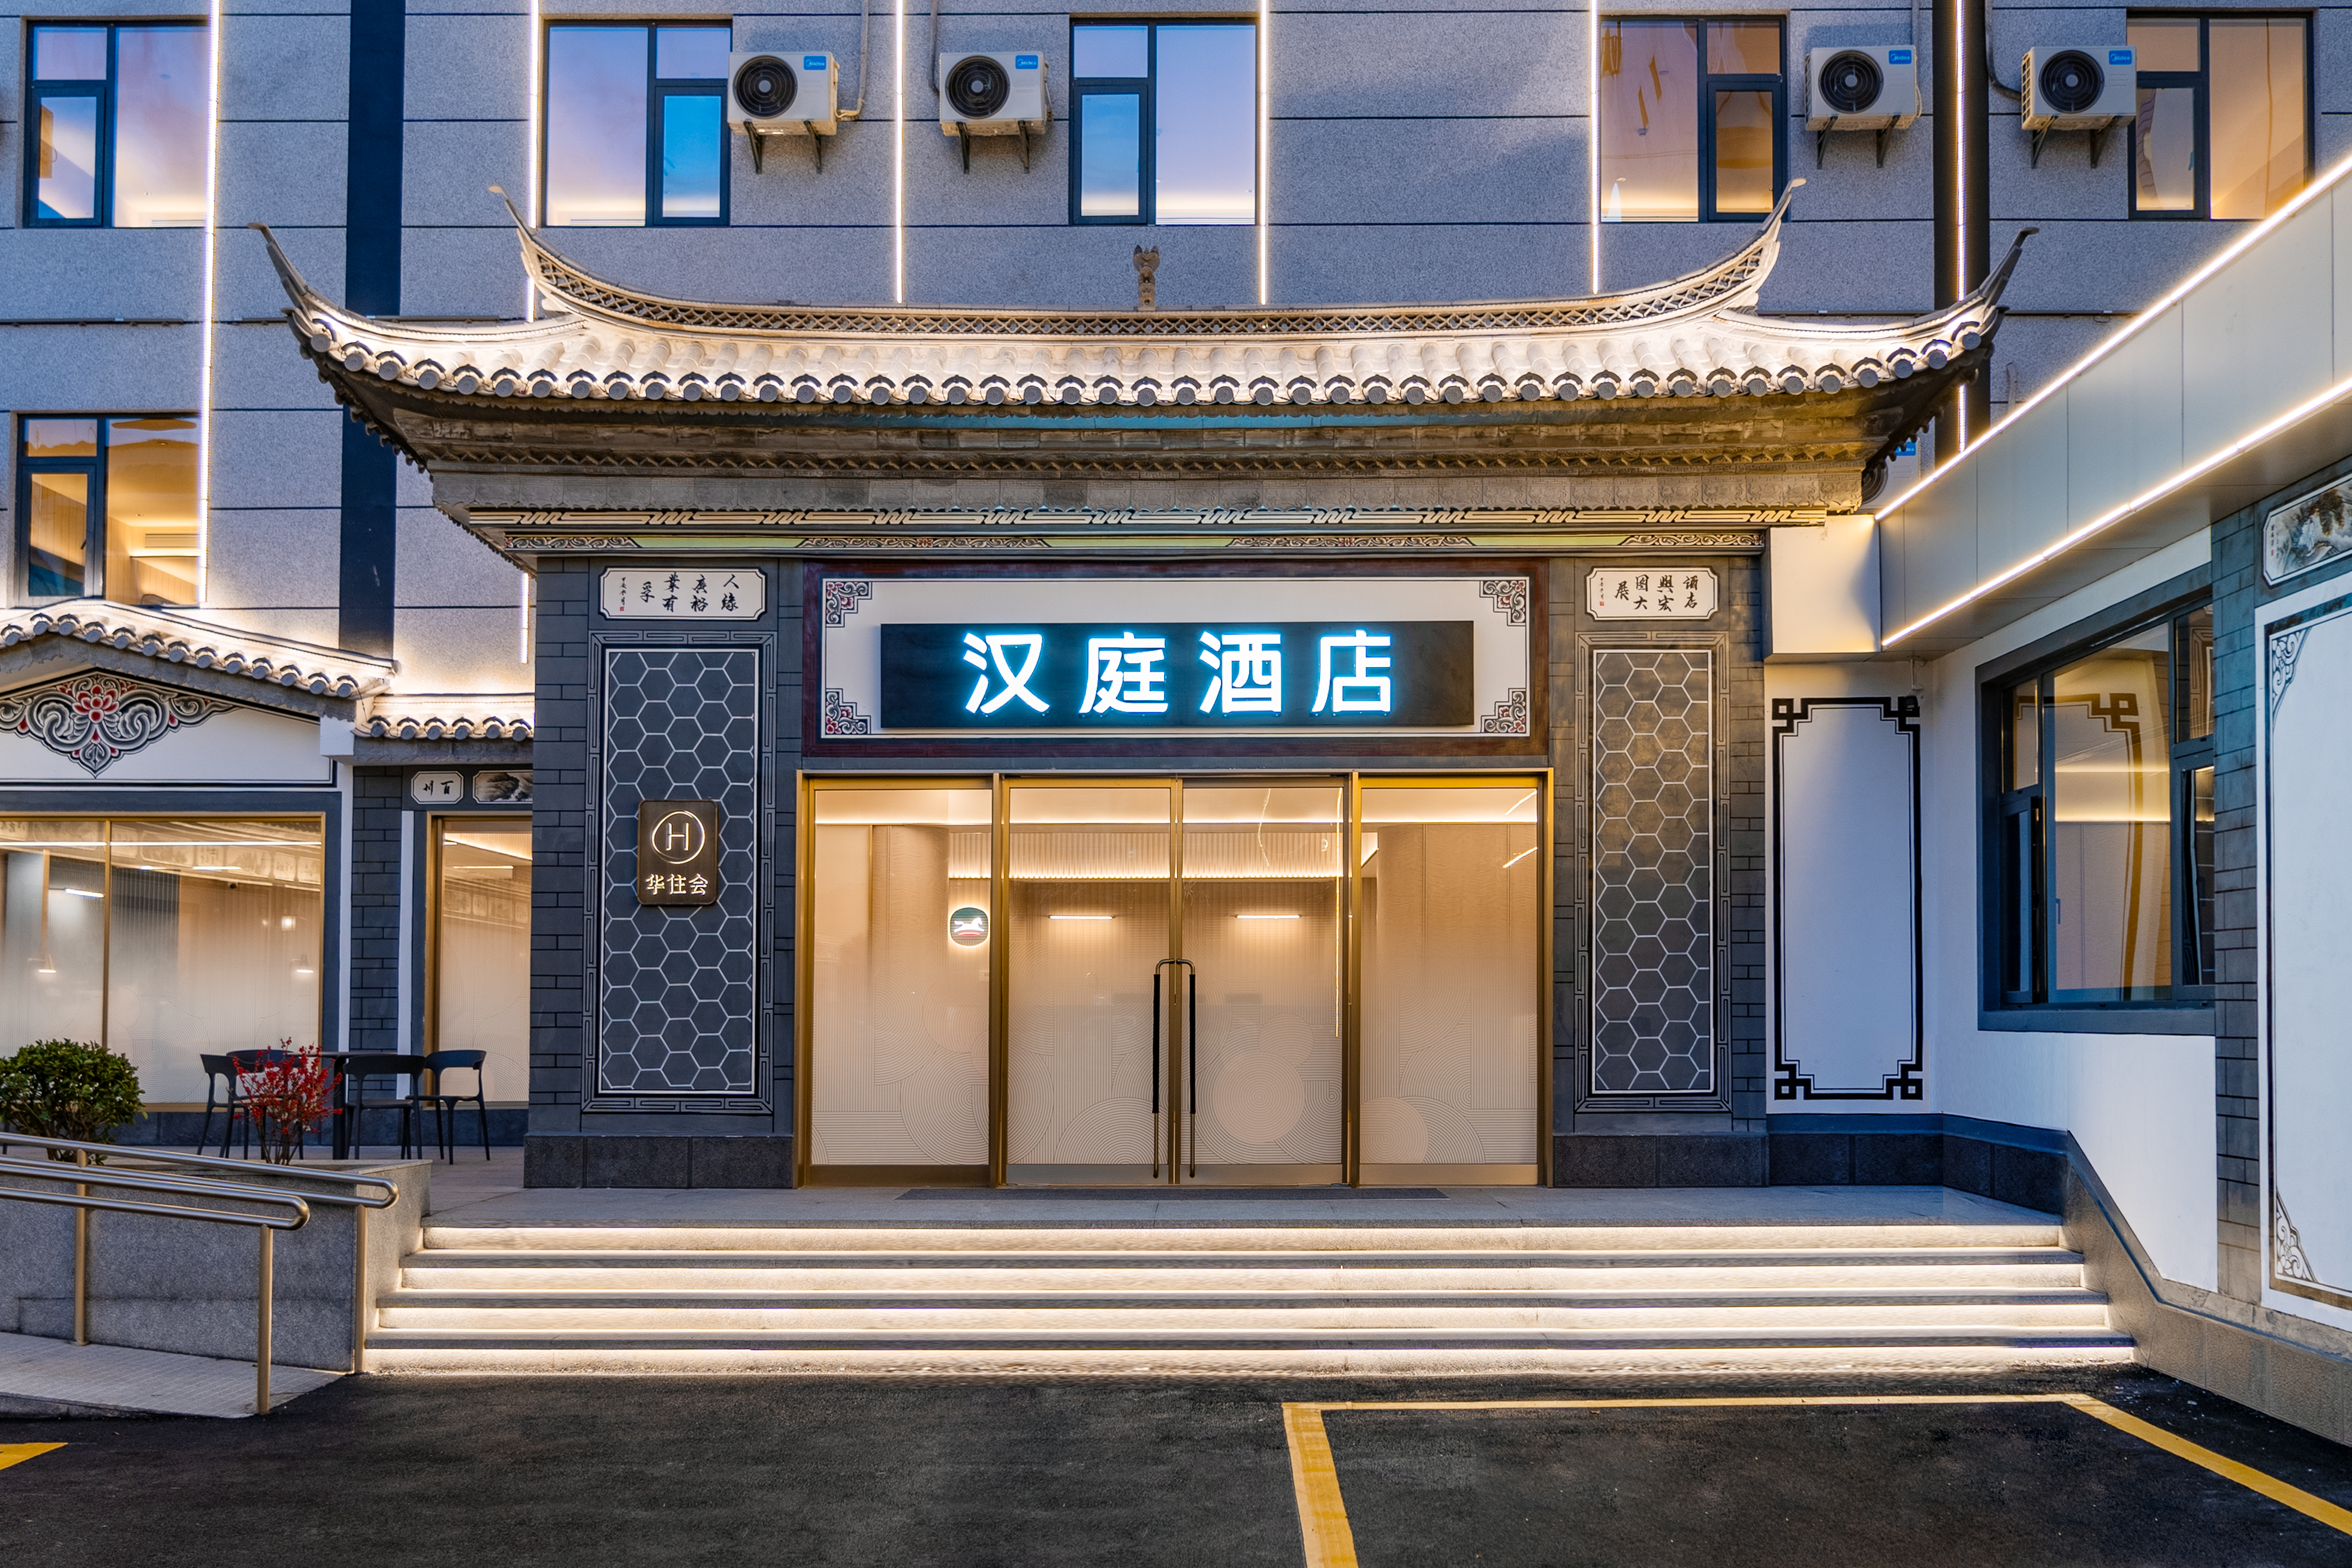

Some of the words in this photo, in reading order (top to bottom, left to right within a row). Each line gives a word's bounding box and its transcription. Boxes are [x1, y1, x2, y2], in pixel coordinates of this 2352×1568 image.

[962, 629, 1391, 713] 汉庭酒店
[665, 822, 690, 851] H
[646, 873, 709, 895] 华住会
